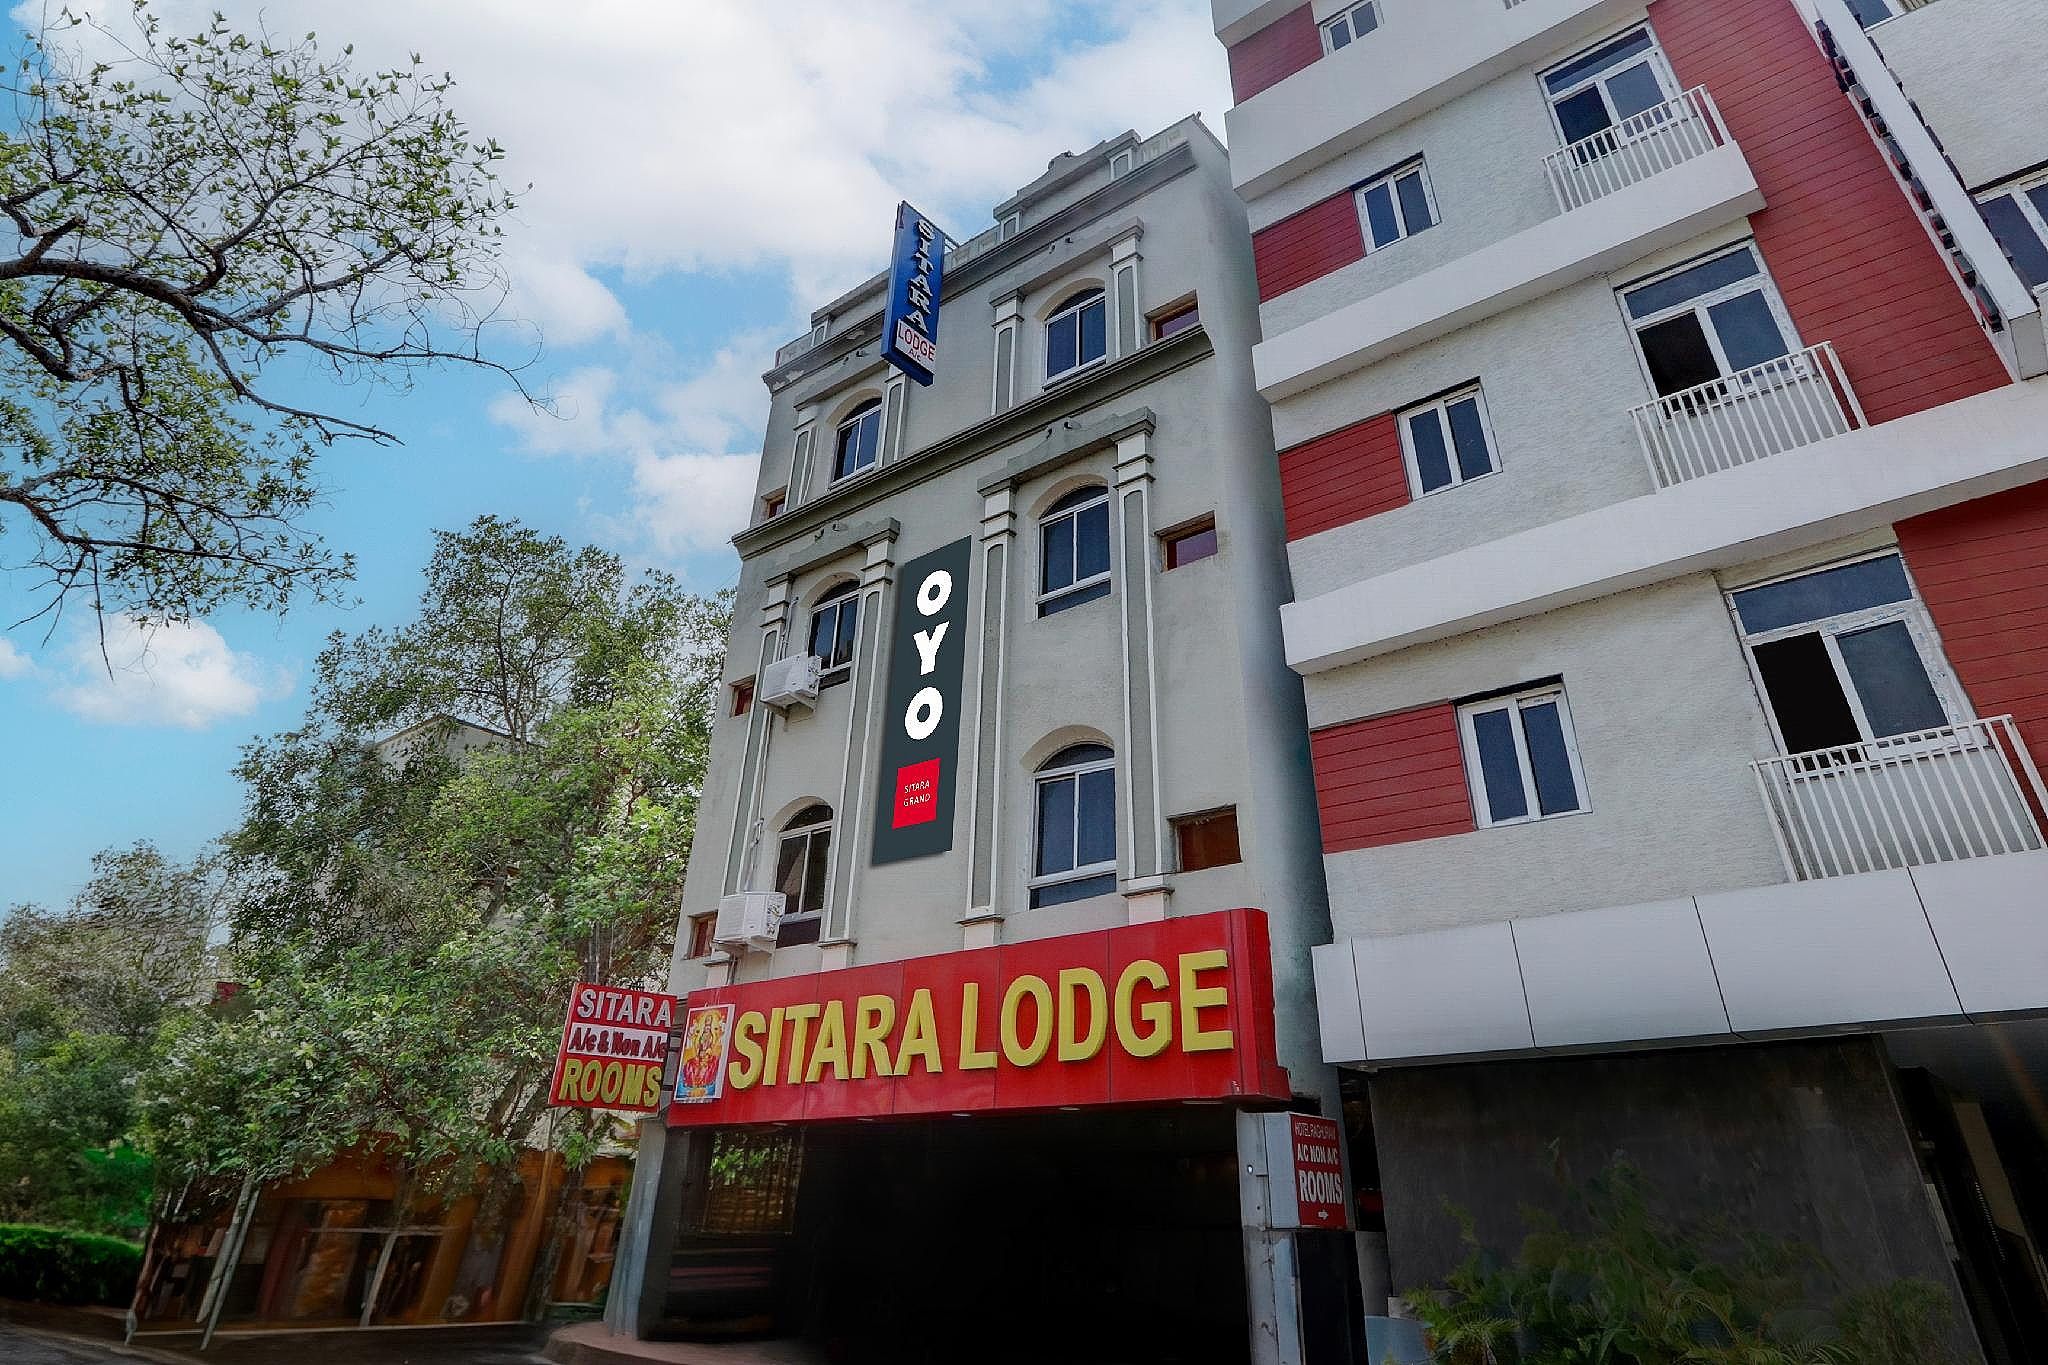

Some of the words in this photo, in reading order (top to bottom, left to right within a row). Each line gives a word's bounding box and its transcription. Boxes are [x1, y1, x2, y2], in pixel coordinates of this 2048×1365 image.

[905, 219, 936, 334] SITARA
[898, 322, 936, 361] LODGE
[904, 569, 953, 740] OYO
[903, 793, 931, 807] GRAND
[904, 780, 930, 793] SITARA
[577, 988, 672, 1028] SITARA
[728, 986, 943, 1090] SITARA
[958, 949, 1234, 1070] LODGE
[597, 1030, 609, 1054] &
[558, 1058, 662, 1107] ROOMS
[1309, 1144, 1327, 1164] NON
[1299, 1169, 1343, 1205] ROOMS
